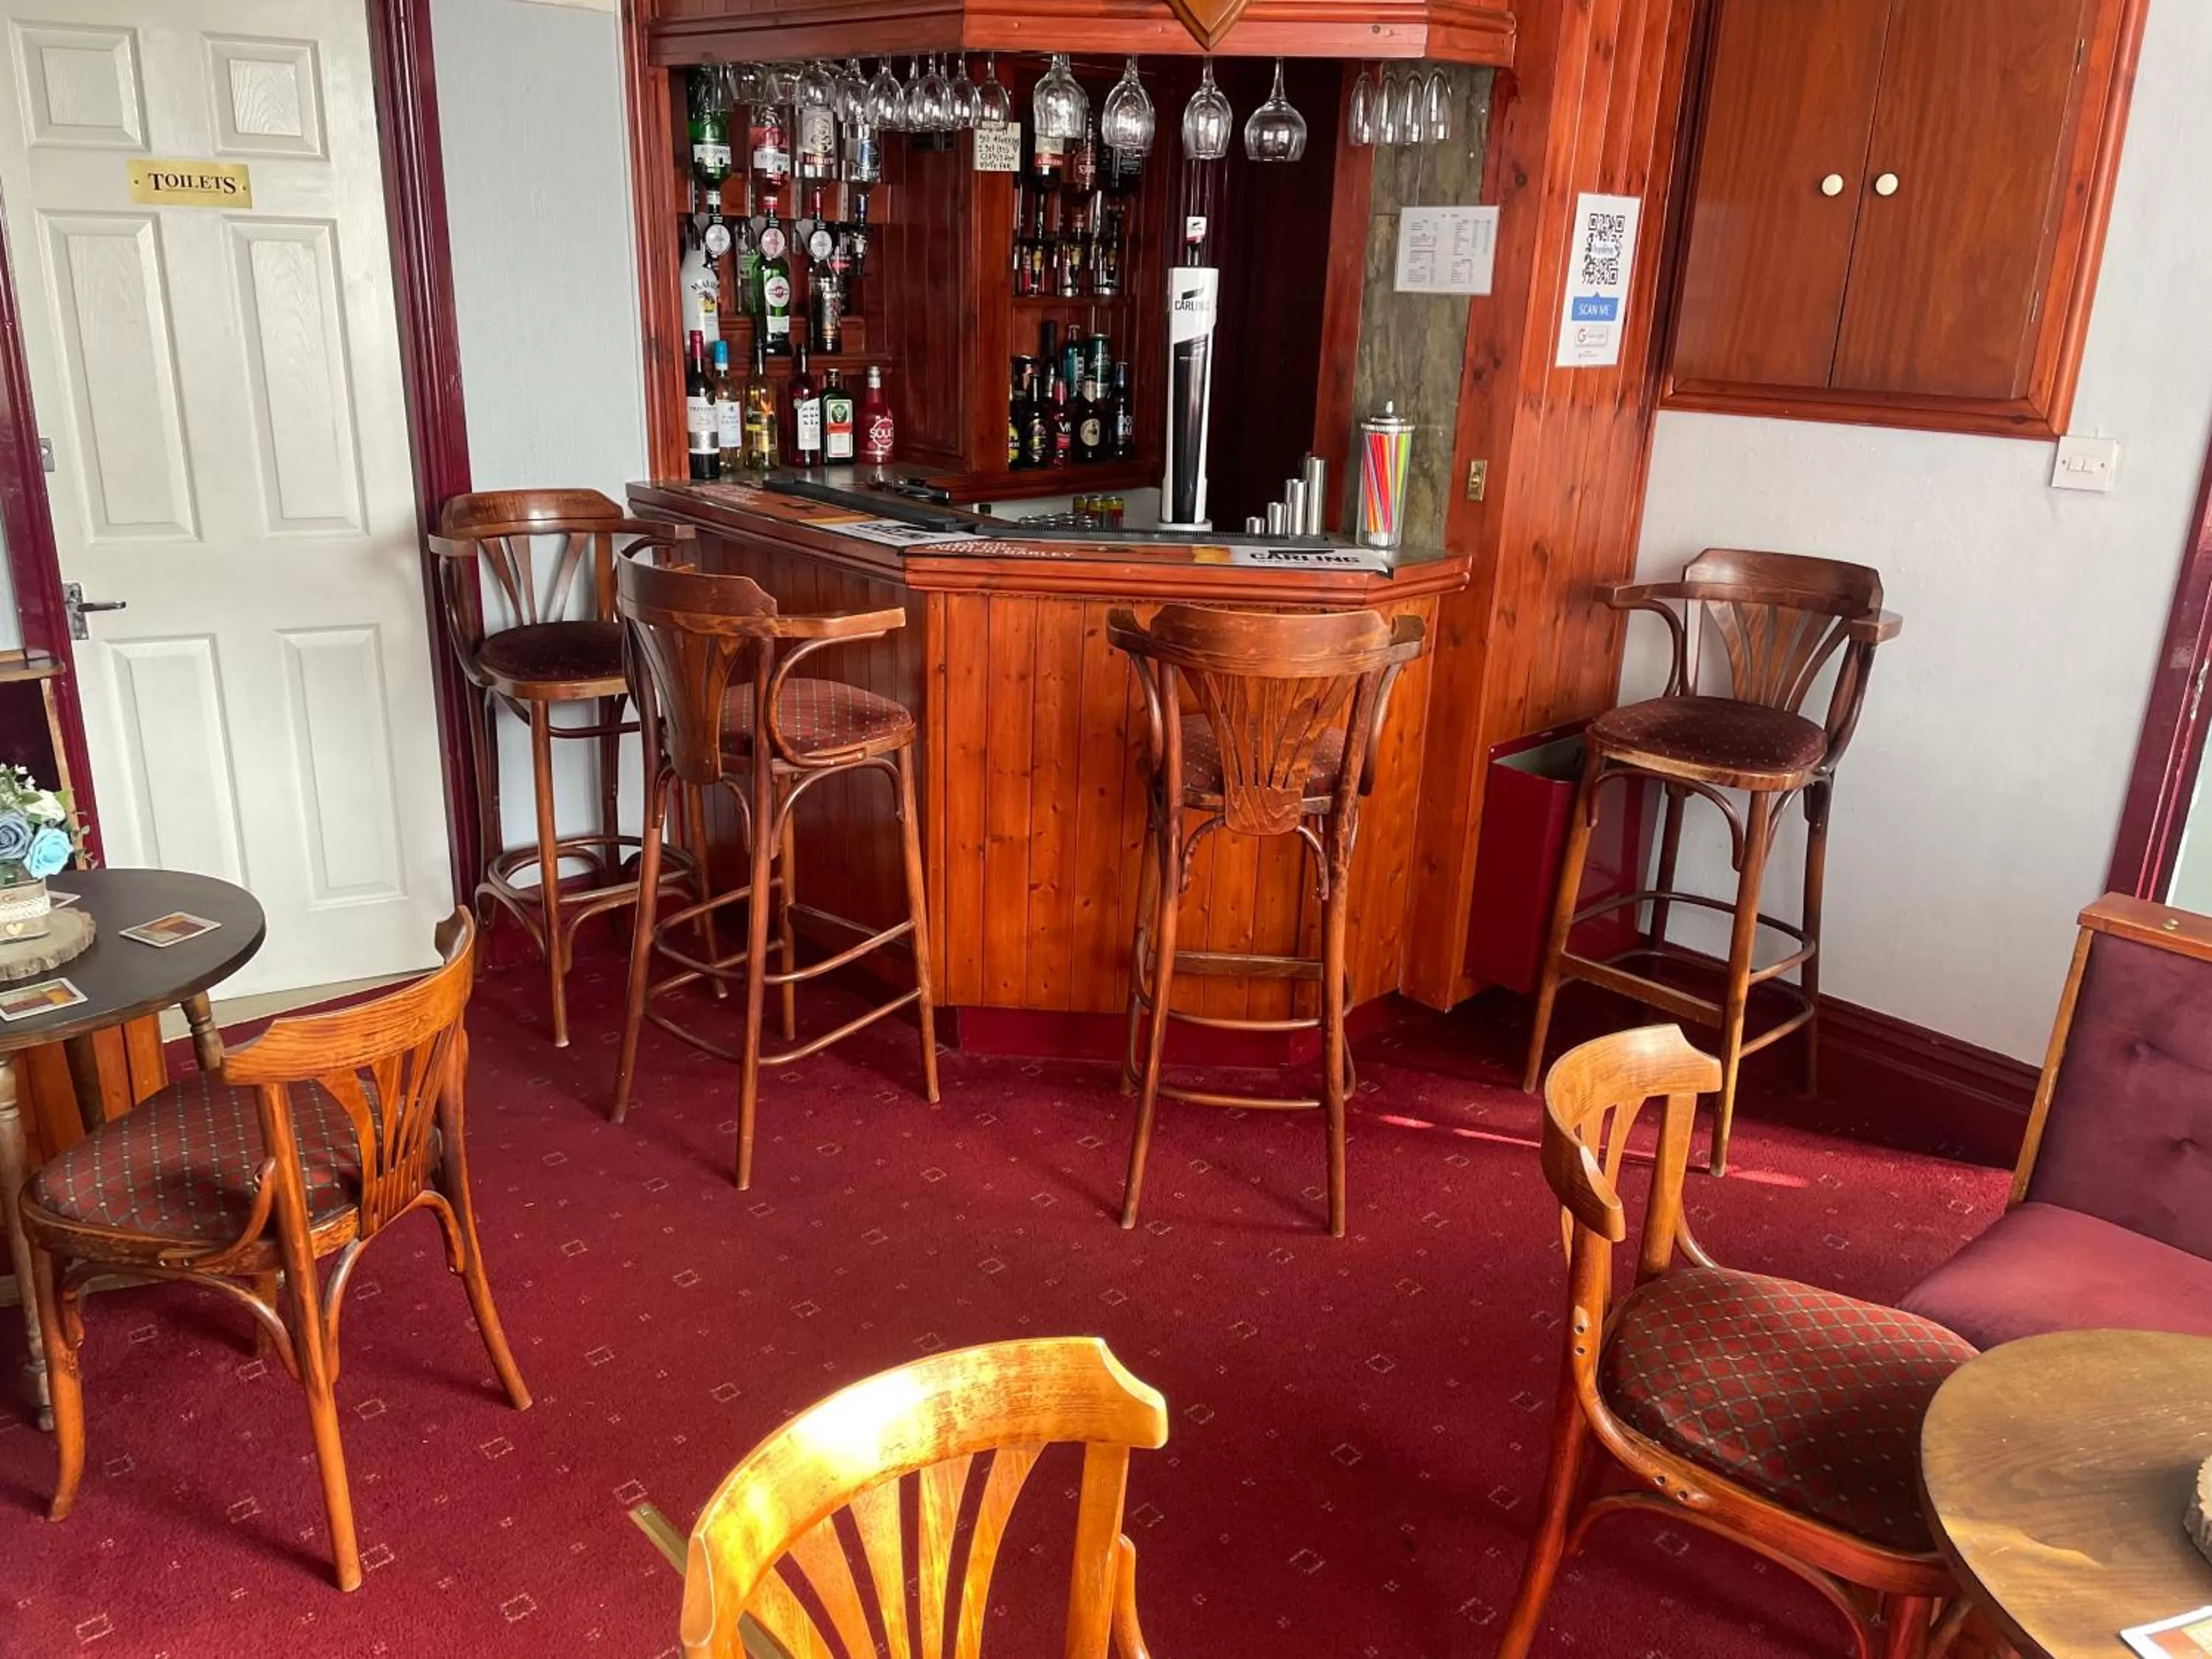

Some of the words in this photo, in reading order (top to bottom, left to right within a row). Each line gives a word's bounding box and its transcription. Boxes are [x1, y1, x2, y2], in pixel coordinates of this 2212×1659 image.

[147, 173, 237, 194] TOILETS
[1578, 304, 1599, 316] SCAN
[1599, 304, 1611, 316] ME
[1250, 553, 1360, 563] CARLING
